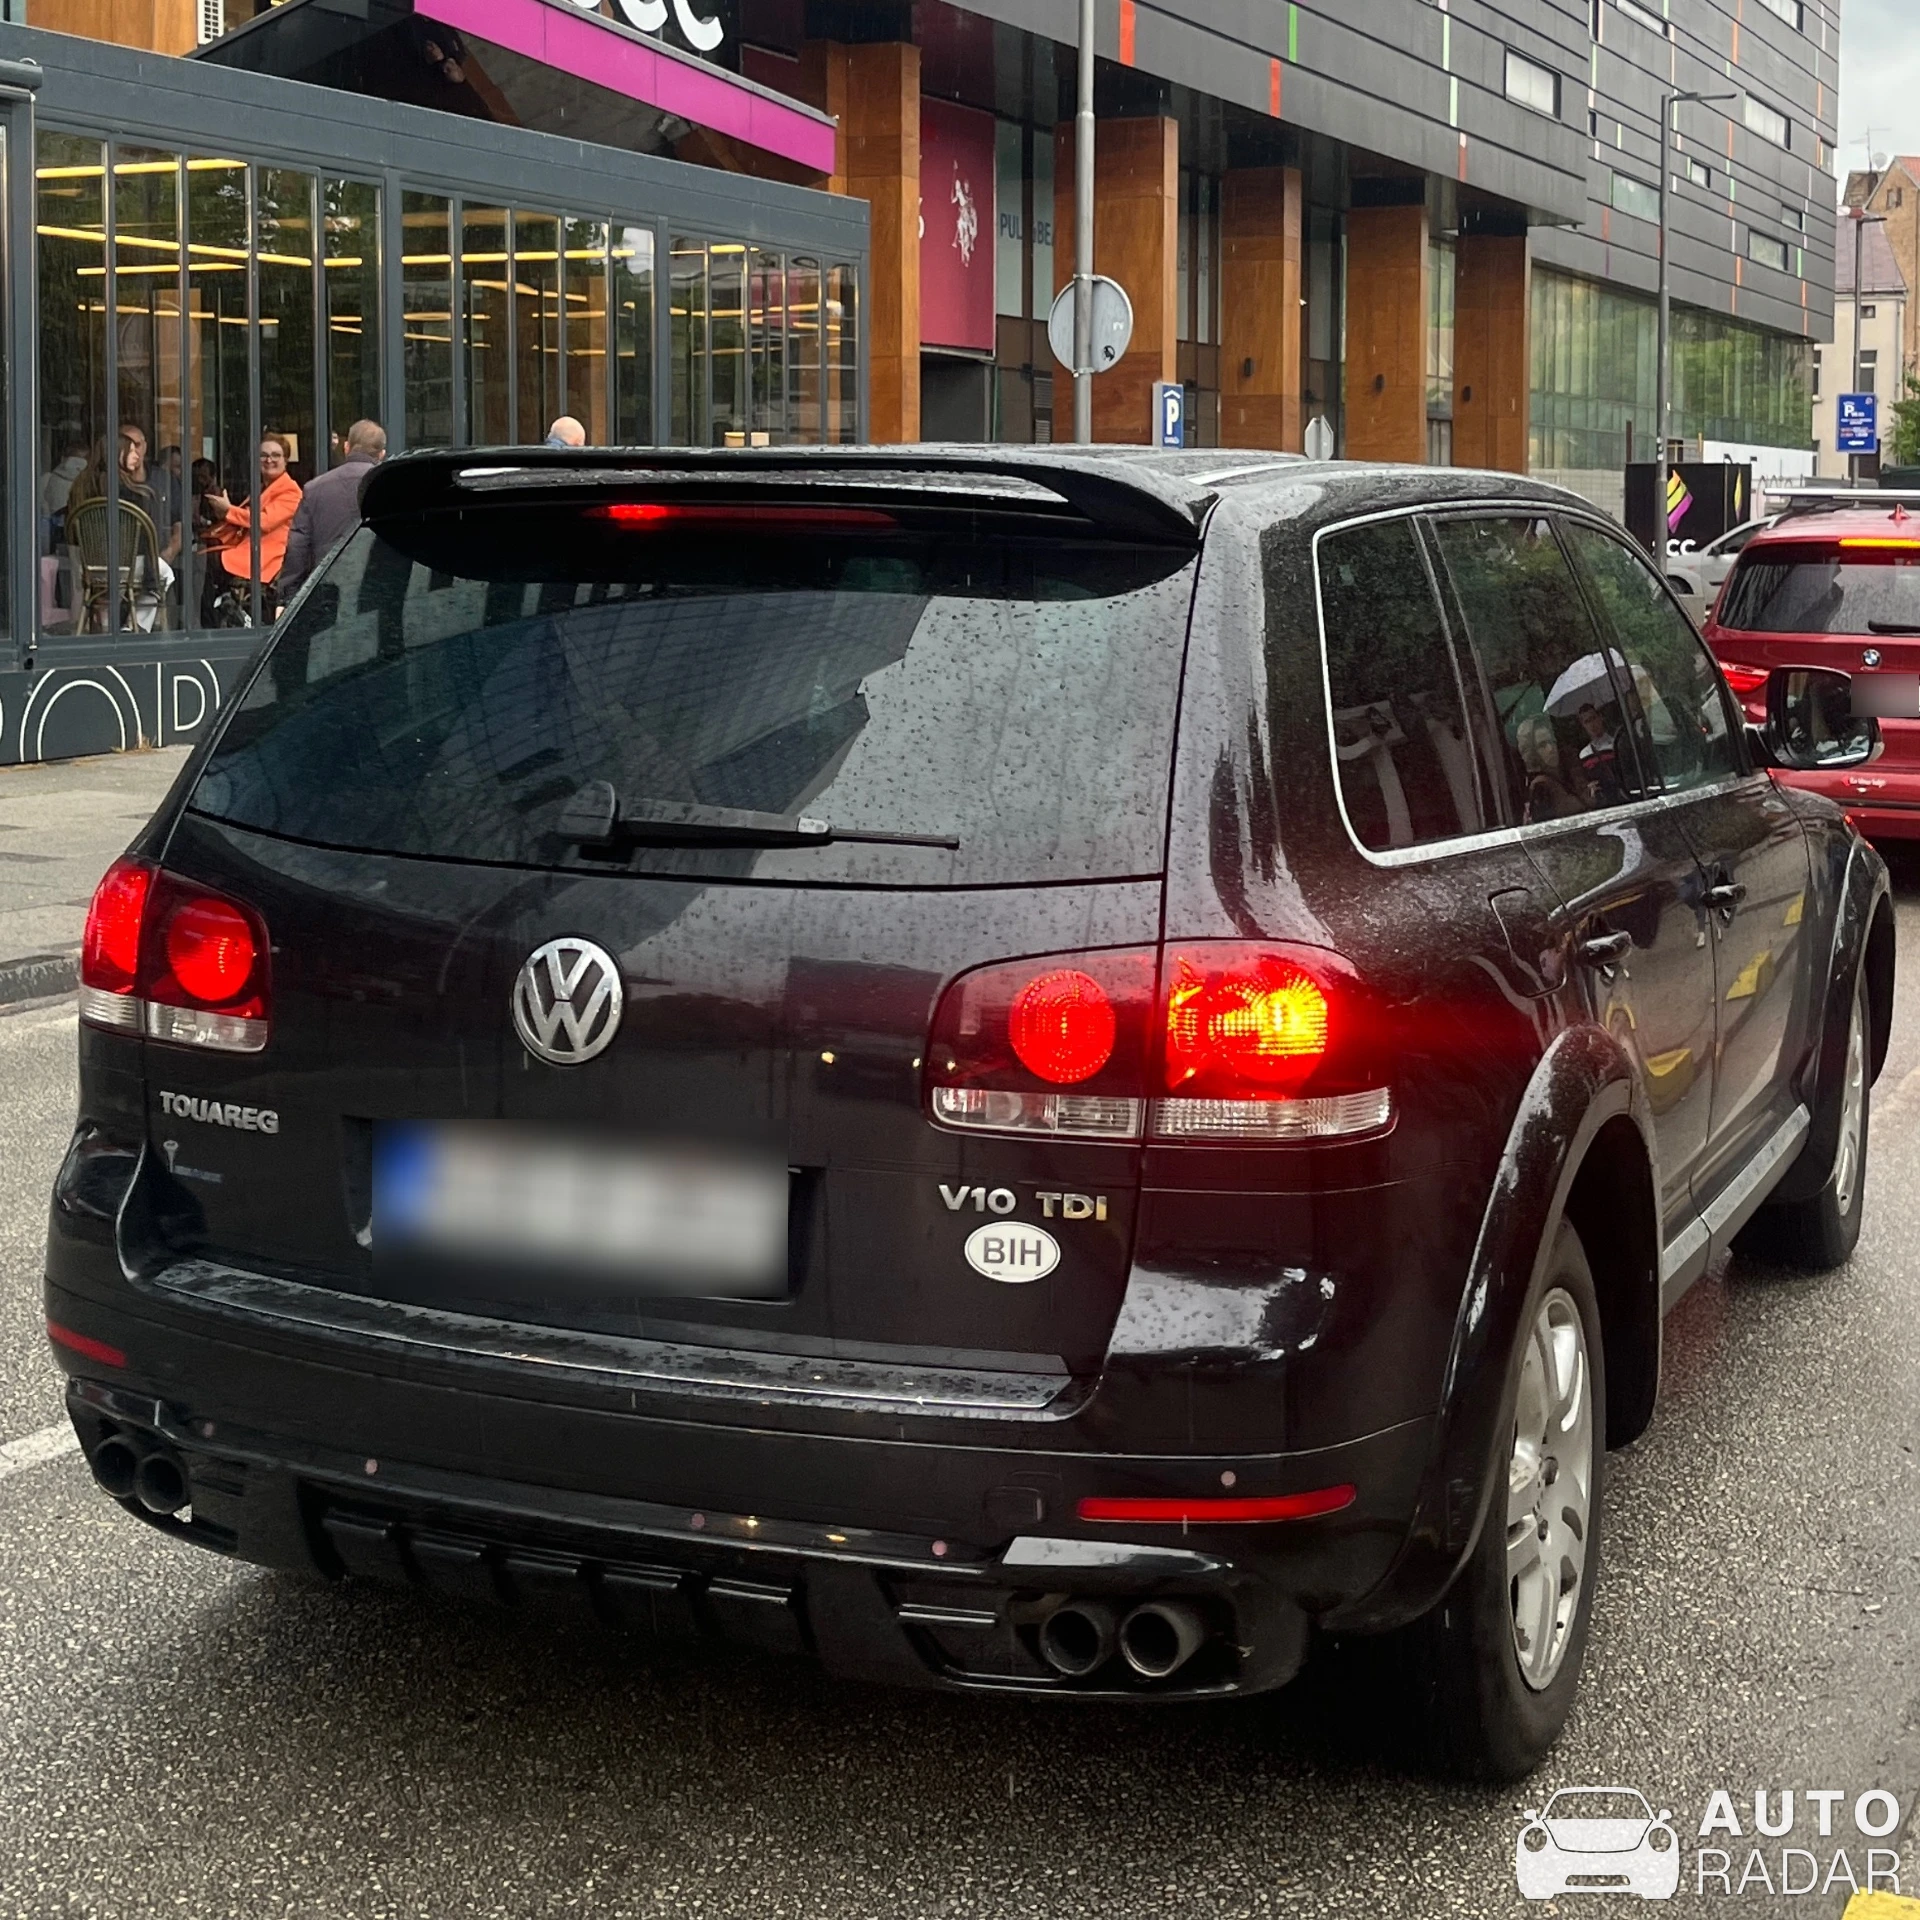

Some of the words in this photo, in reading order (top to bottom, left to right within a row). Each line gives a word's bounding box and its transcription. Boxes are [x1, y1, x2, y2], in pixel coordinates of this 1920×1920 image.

[1166, 398, 1179, 435] P
[159, 1090, 280, 1134] TOUAREG
[938, 1184, 1017, 1215] V10
[1035, 1191, 1108, 1221] TDI
[983, 1236, 1042, 1267] BIH
